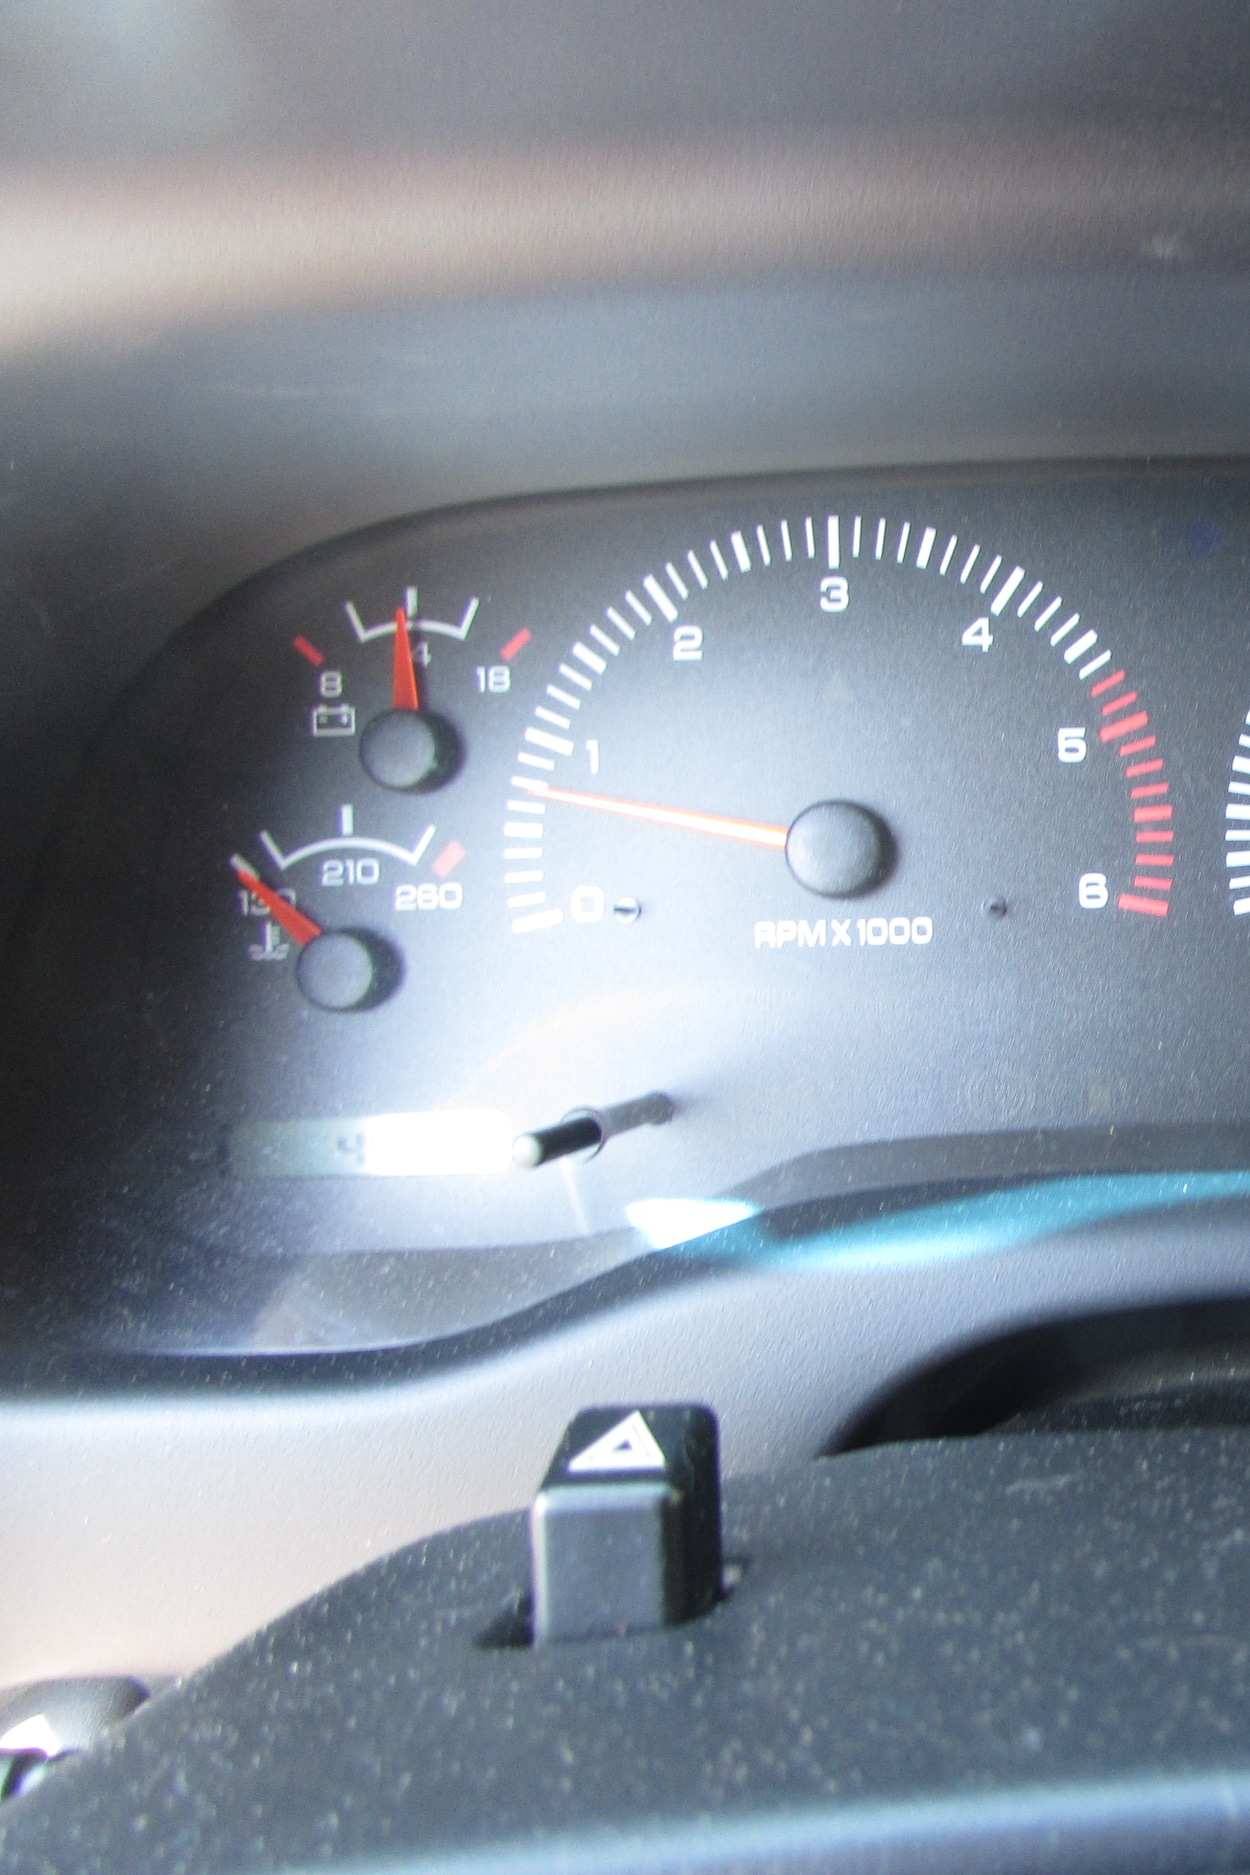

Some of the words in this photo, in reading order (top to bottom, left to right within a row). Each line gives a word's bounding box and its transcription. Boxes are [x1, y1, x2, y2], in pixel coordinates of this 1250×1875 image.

[820, 576, 849, 612] 3
[673, 625, 702, 660] 2
[961, 617, 993, 652] 4
[319, 670, 342, 697] 8
[475, 665, 511, 693] 18
[585, 739, 599, 774] 1
[1058, 728, 1086, 763] 5
[322, 858, 380, 886] 210
[394, 882, 463, 911] 260
[570, 886, 605, 922] 0
[1079, 873, 1108, 909] 6
